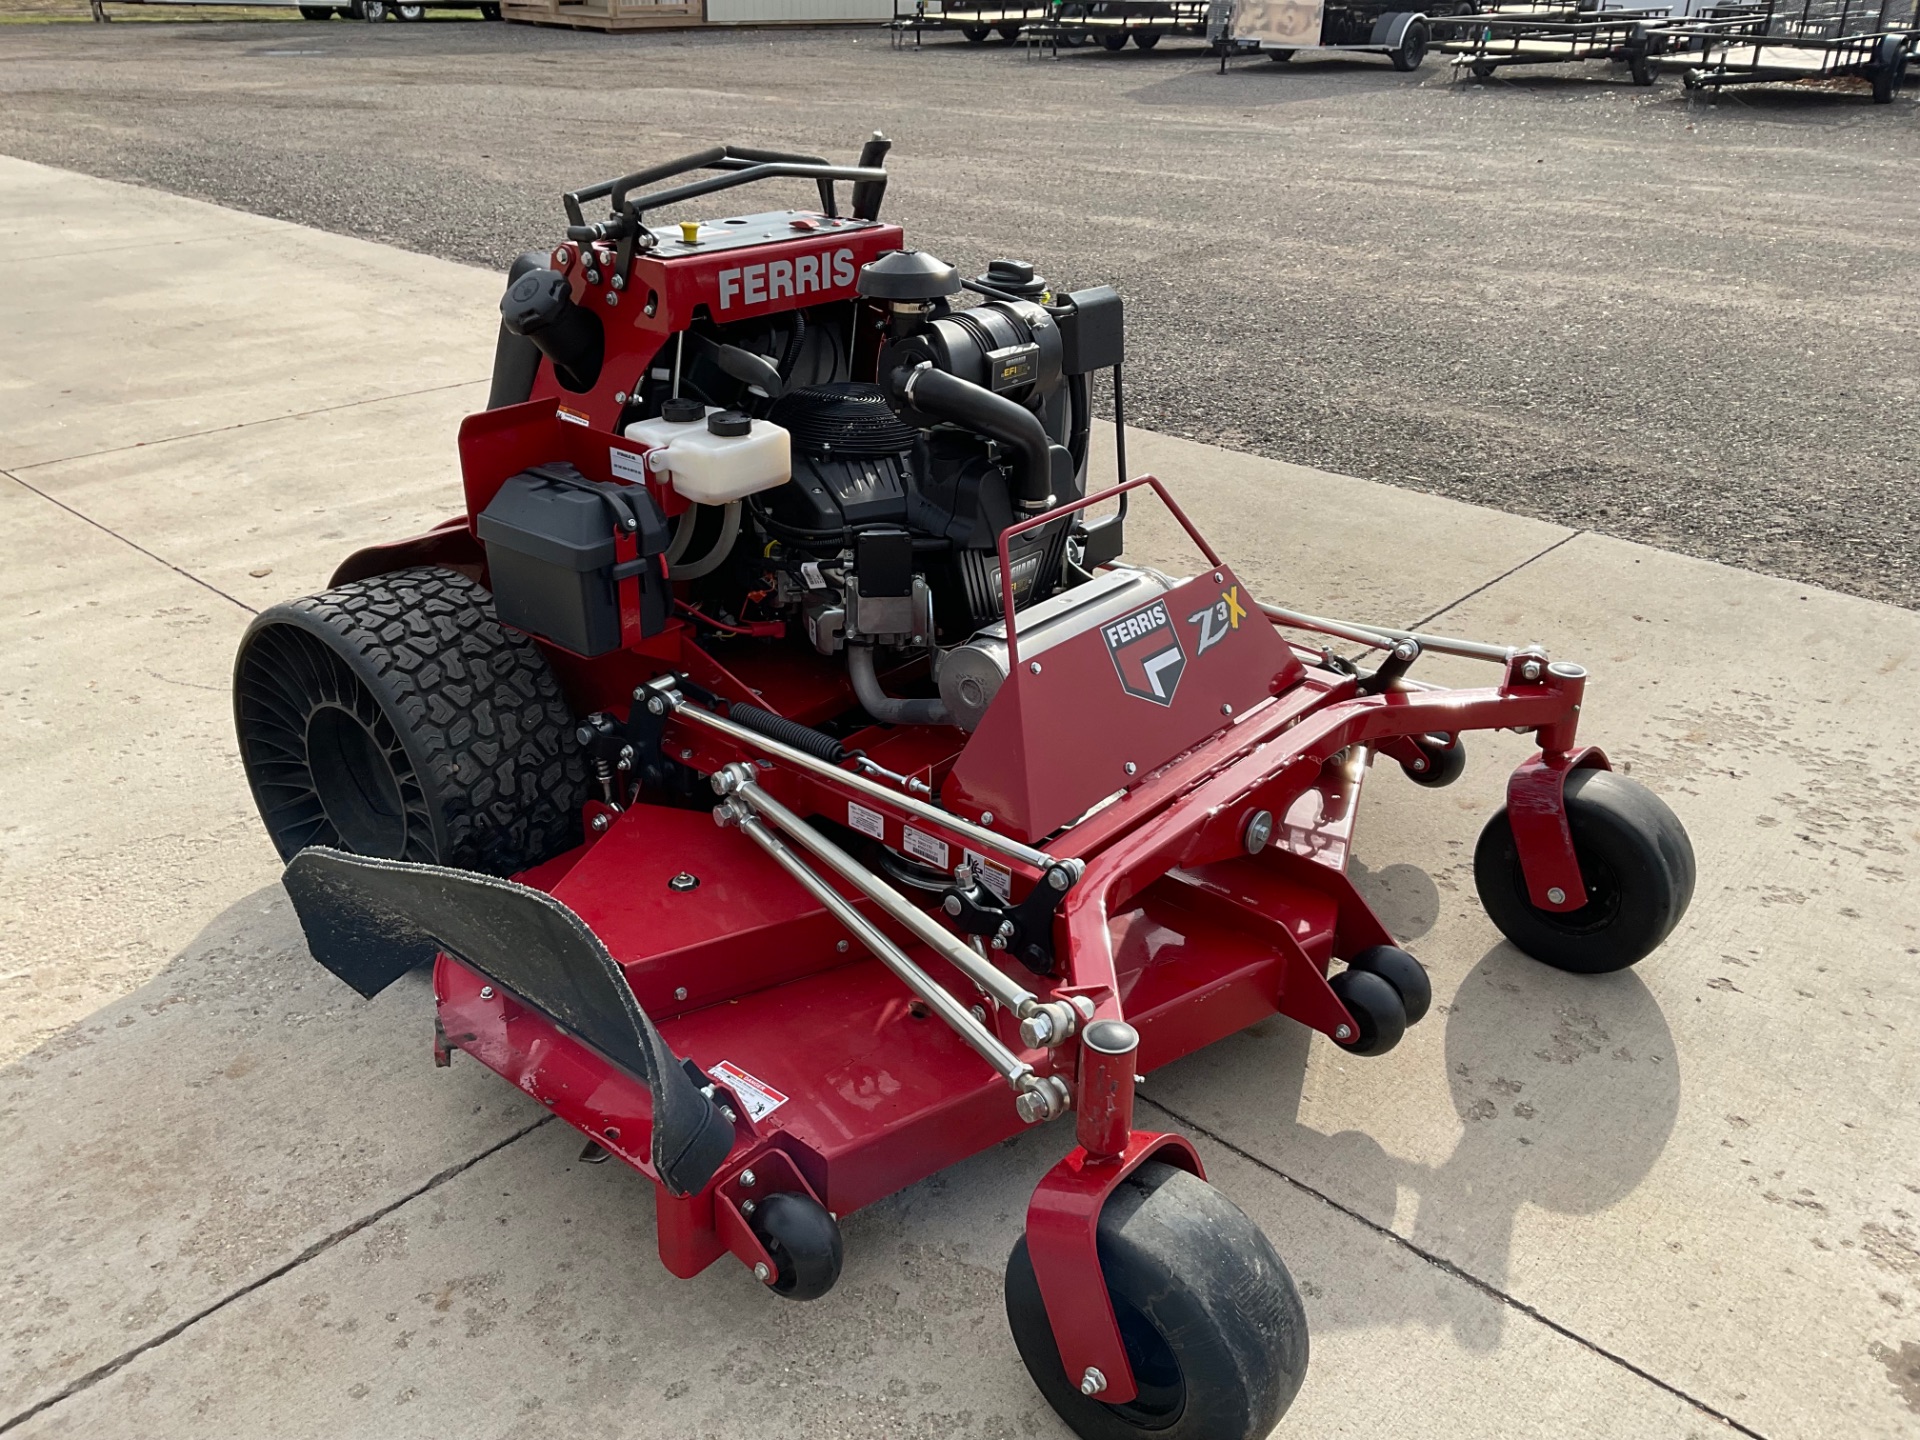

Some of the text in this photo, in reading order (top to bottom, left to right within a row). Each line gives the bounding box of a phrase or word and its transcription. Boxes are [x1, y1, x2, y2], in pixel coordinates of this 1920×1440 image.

[718, 248, 855, 310] FERRIS
[1004, 366, 1017, 377] EFI
[995, 558, 1037, 586] VGUARD
[1107, 606, 1166, 648] FERRIS
[743, 1076, 766, 1091] DANGER
